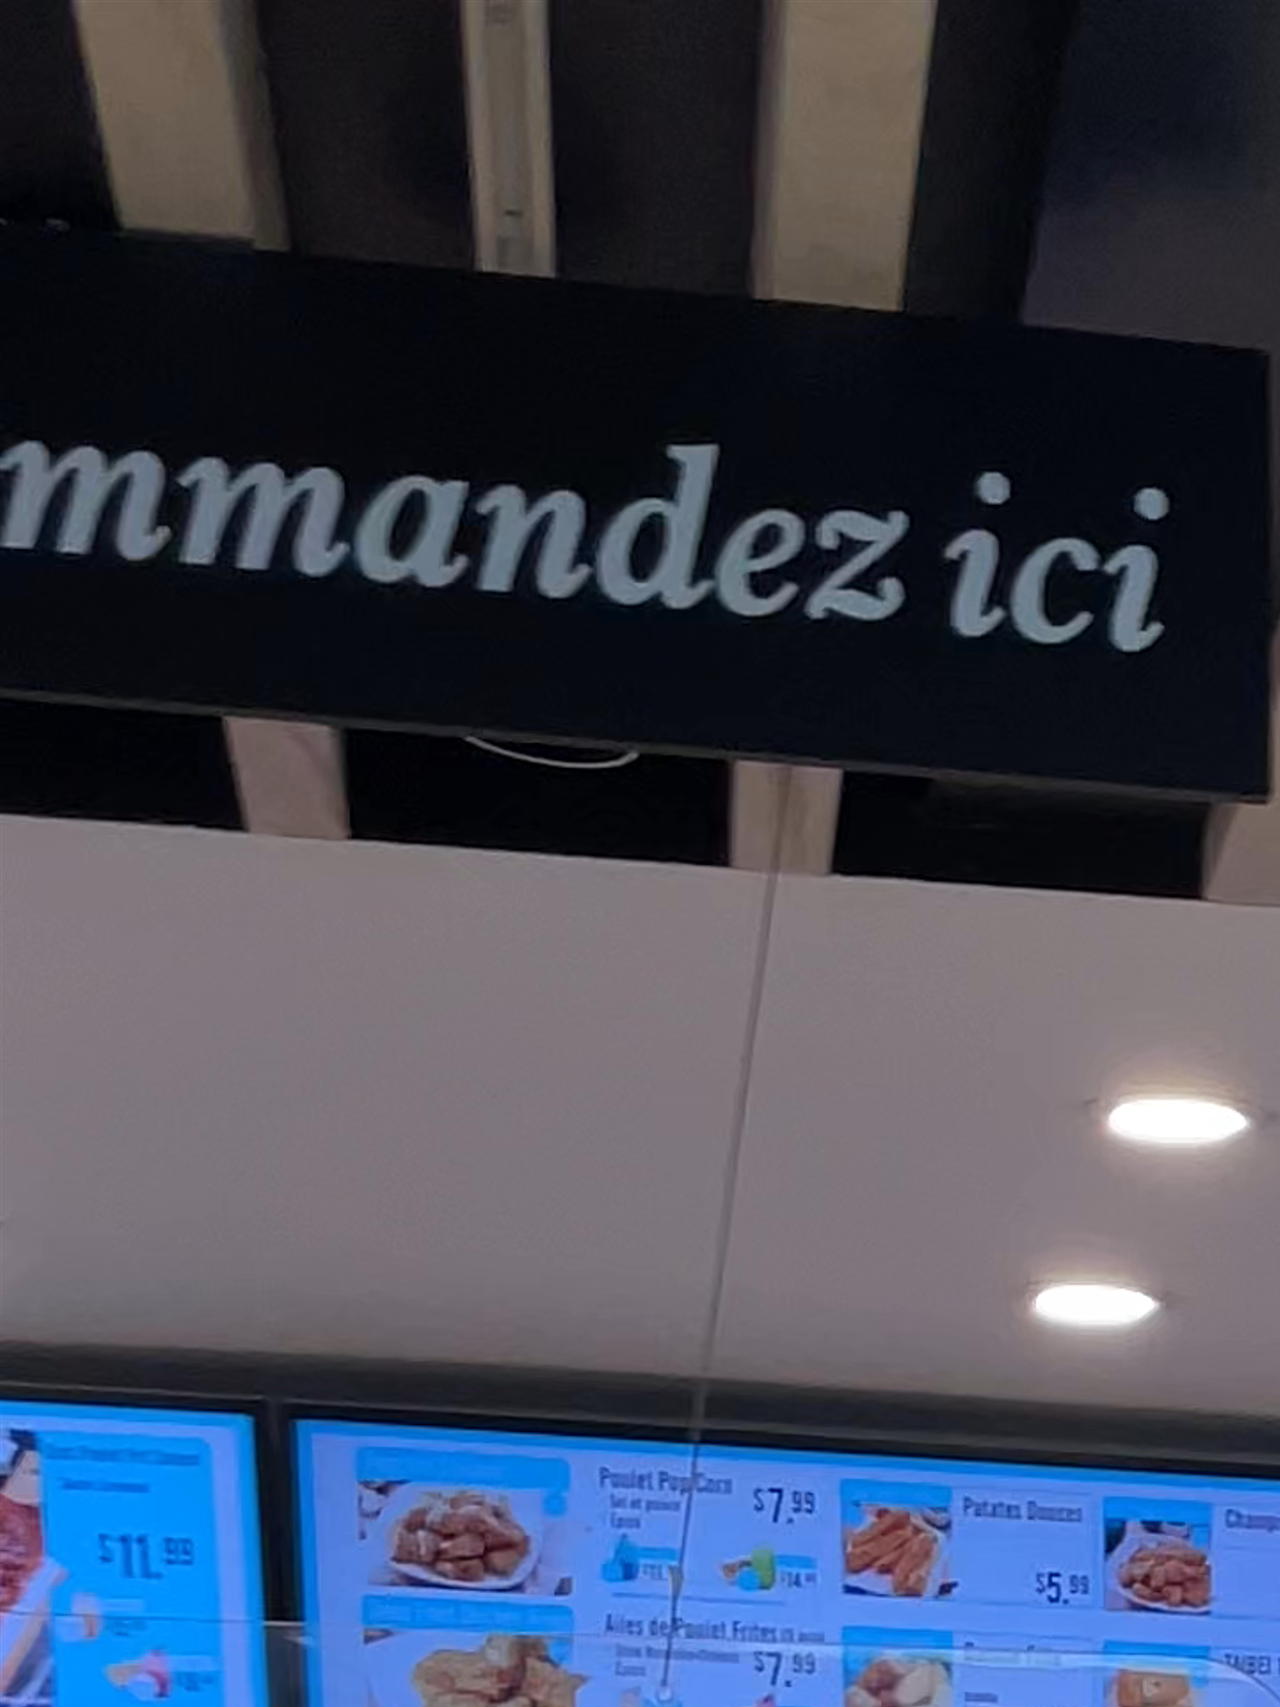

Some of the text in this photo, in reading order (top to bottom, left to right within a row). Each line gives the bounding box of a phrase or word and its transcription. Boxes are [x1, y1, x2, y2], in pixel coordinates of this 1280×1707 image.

[944, 470, 1170, 653] ici
[753, 1487, 816, 1524] $7.99
[1036, 1572, 1090, 1605] $5.99
[754, 1650, 816, 1687] $7.99
